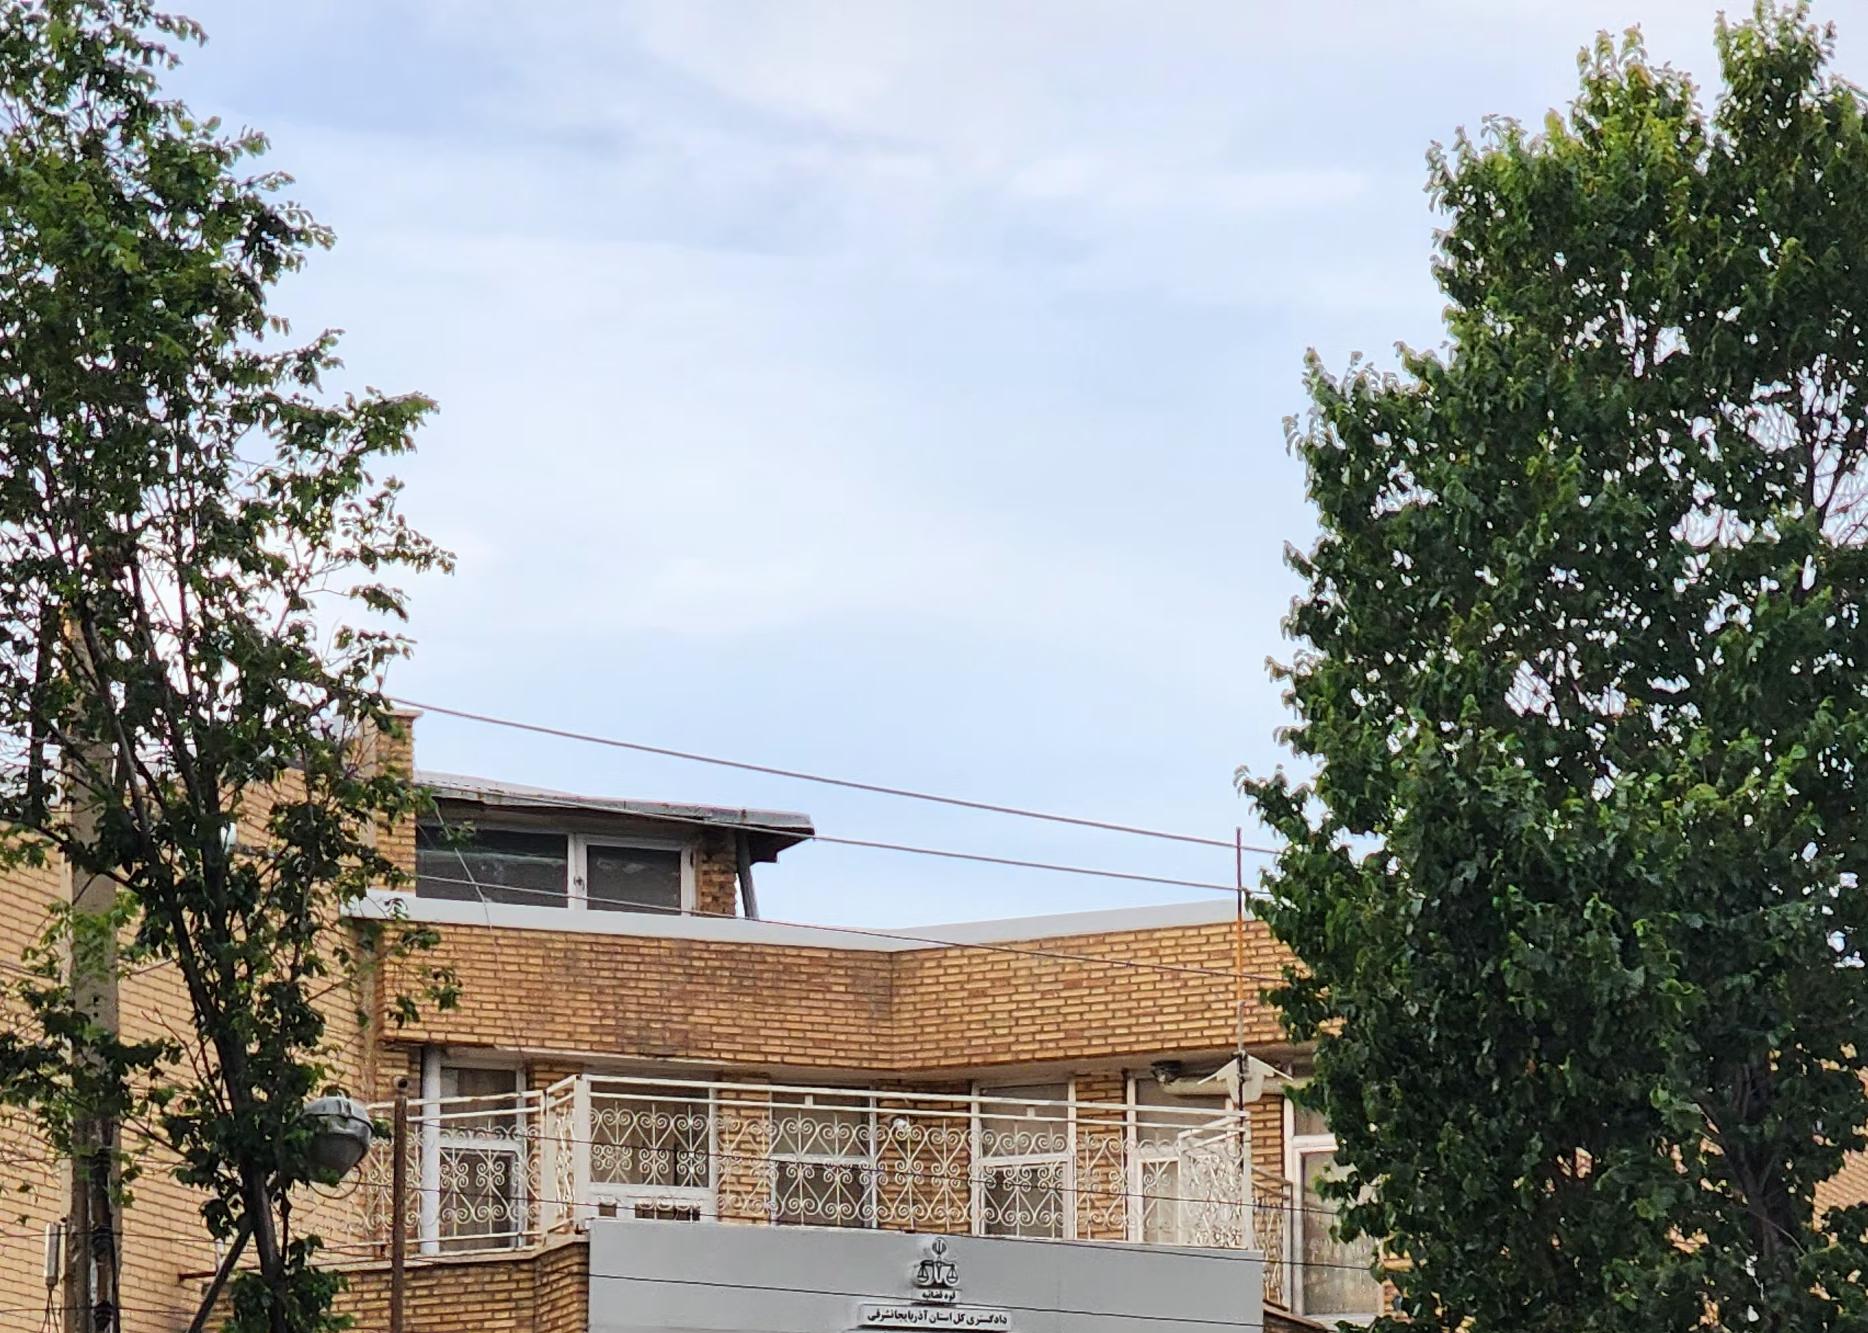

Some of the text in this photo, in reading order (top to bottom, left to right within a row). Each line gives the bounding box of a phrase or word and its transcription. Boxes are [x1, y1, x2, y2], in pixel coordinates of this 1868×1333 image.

[929, 1312, 953, 1325] استان
[953, 1312, 966, 1325] کل
[967, 1314, 1008, 1327] دادگستری
